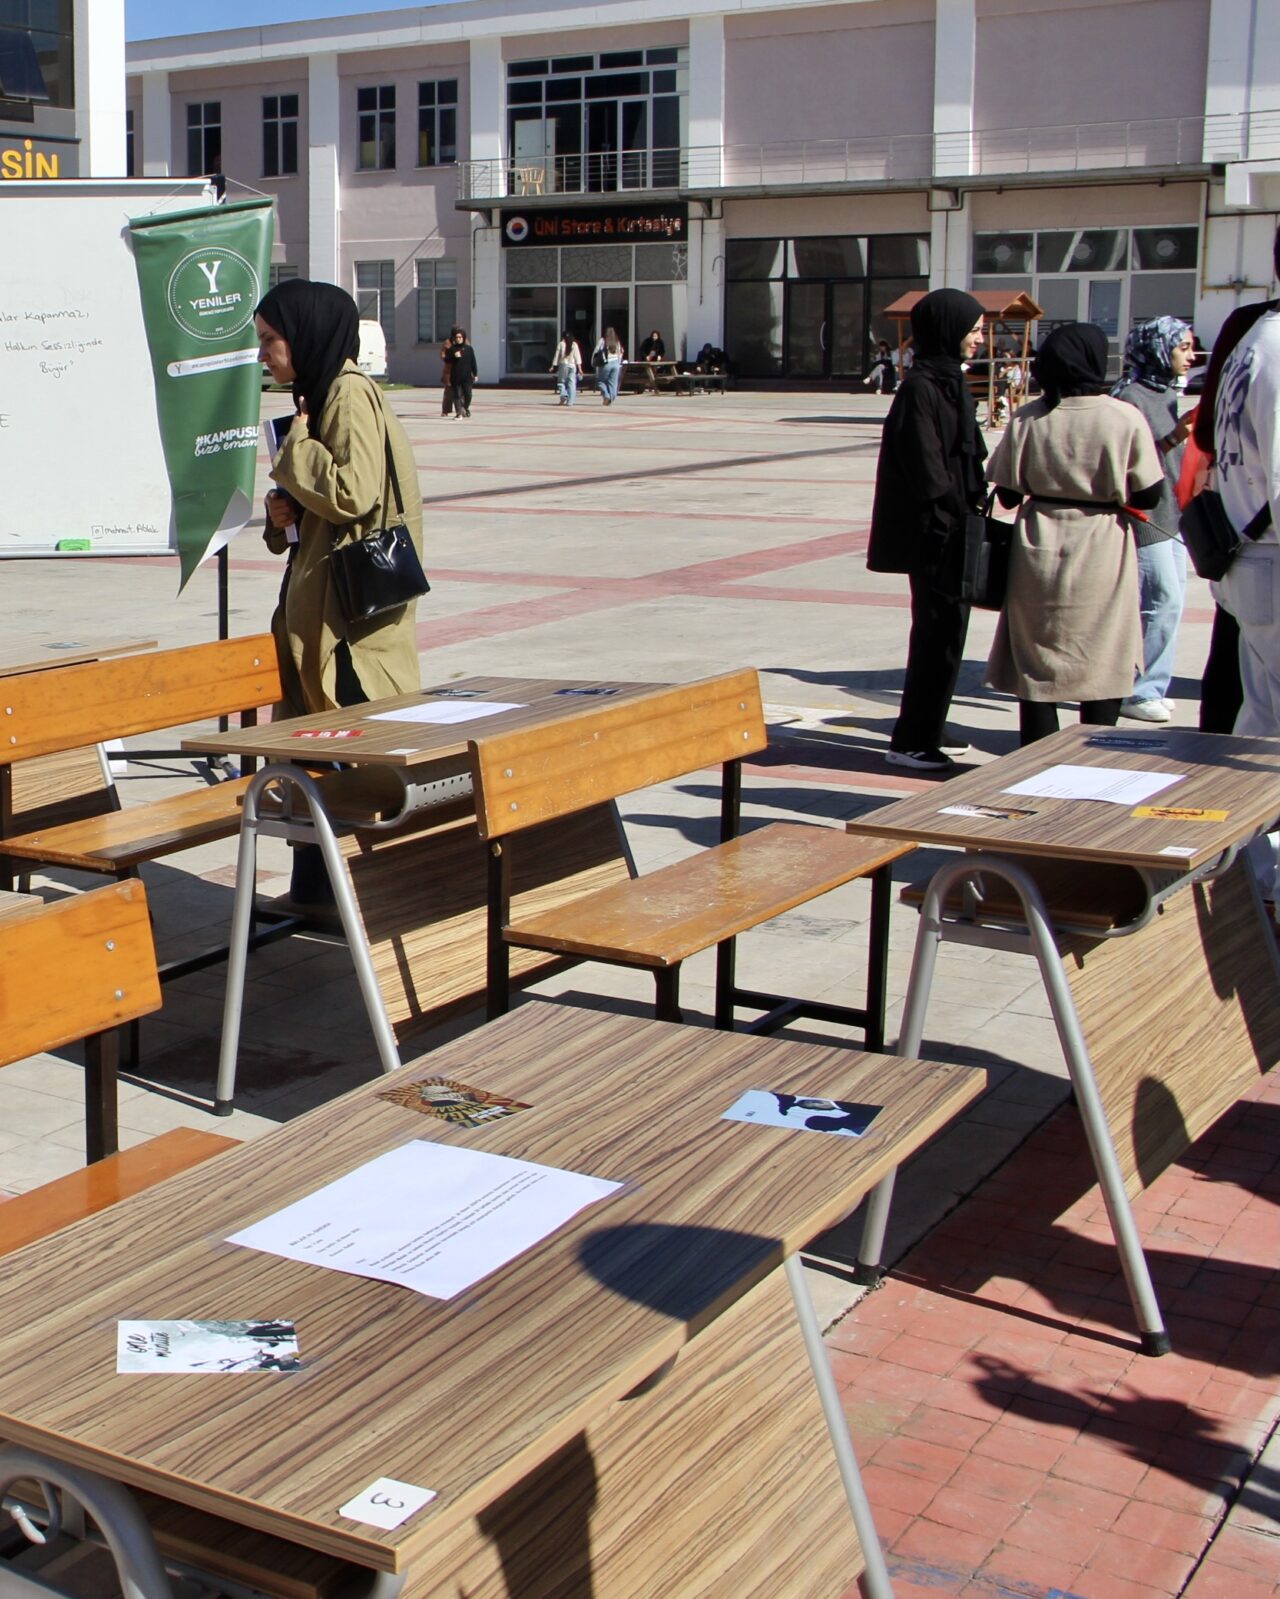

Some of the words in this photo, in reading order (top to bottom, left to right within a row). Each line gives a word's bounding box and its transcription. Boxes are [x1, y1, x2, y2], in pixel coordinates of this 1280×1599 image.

[562, 218, 600, 235] Store
[604, 217, 613, 233] &
[197, 260, 222, 294] Y
[189, 292, 242, 310] YENİLER
[196, 425, 260, 446] #KAMPÜSL
[194, 442, 221, 457] bize
[223, 440, 257, 451] eman
